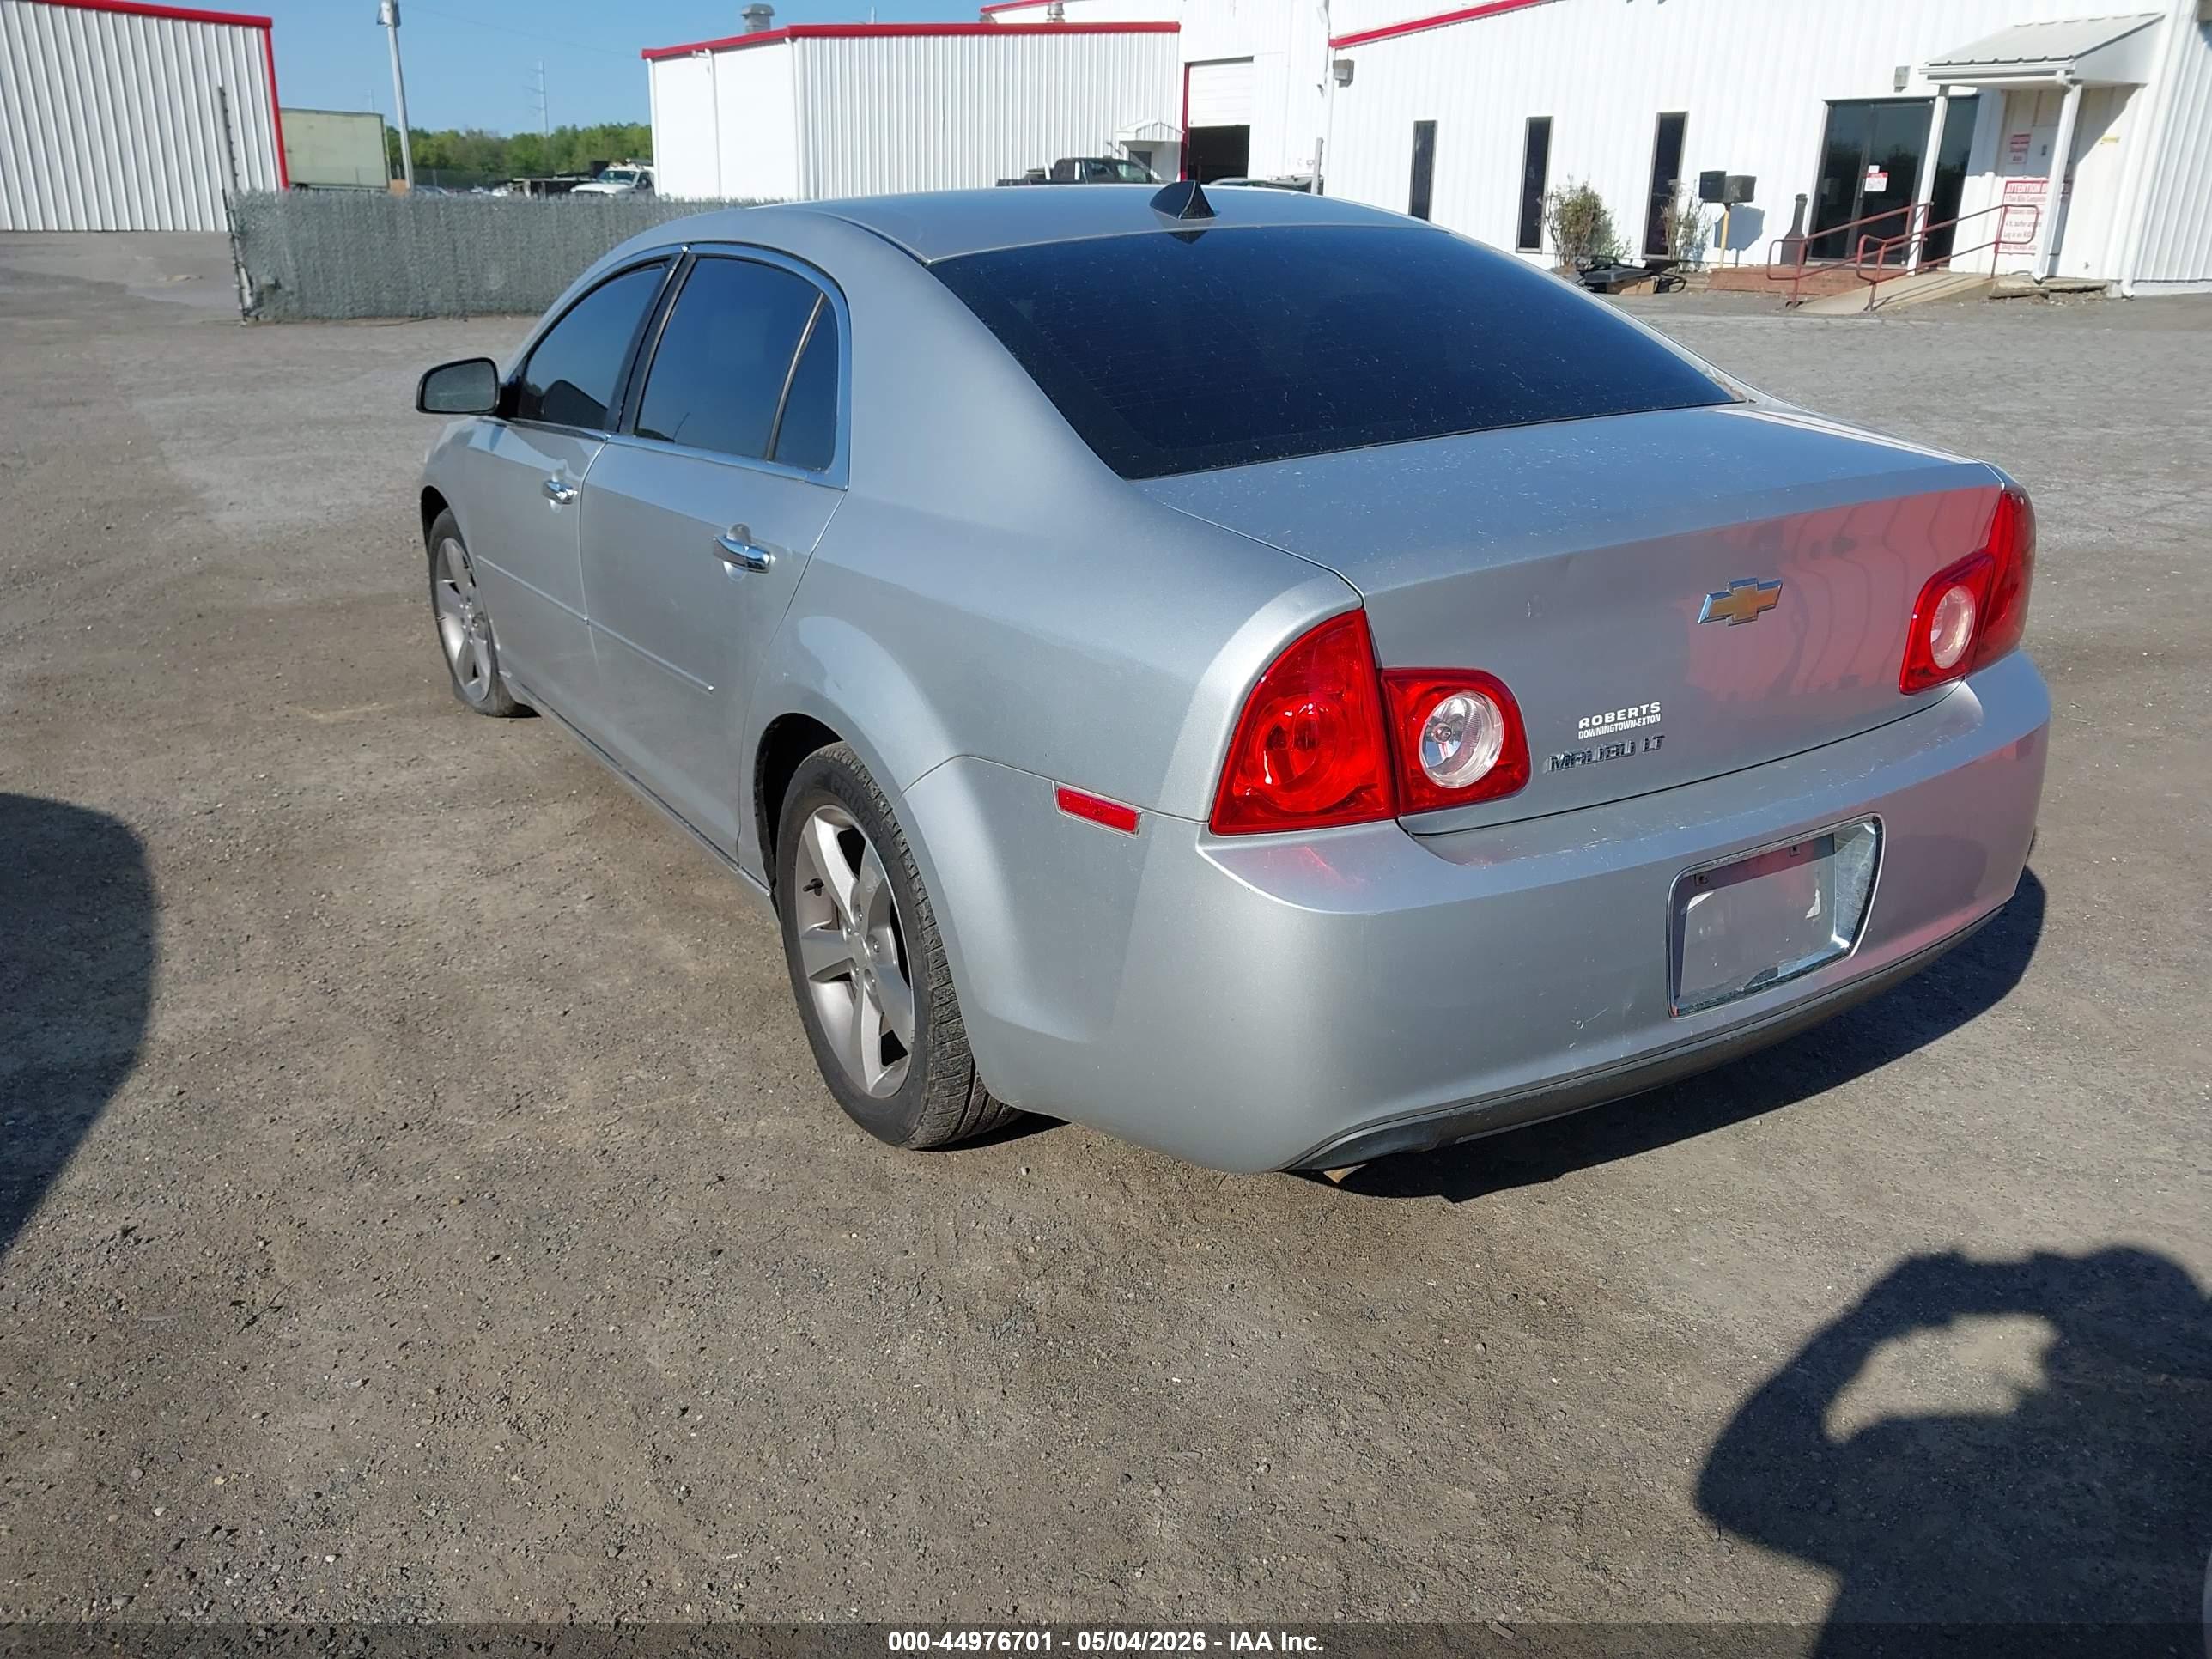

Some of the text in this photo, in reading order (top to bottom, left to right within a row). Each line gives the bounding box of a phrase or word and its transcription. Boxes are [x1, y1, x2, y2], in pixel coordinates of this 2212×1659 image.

[1578, 702, 1661, 729] ROBERTS
[1578, 714, 1661, 740] DOWNINGTOWN-EXTON
[1547, 735, 1665, 774] MALIBU LT
